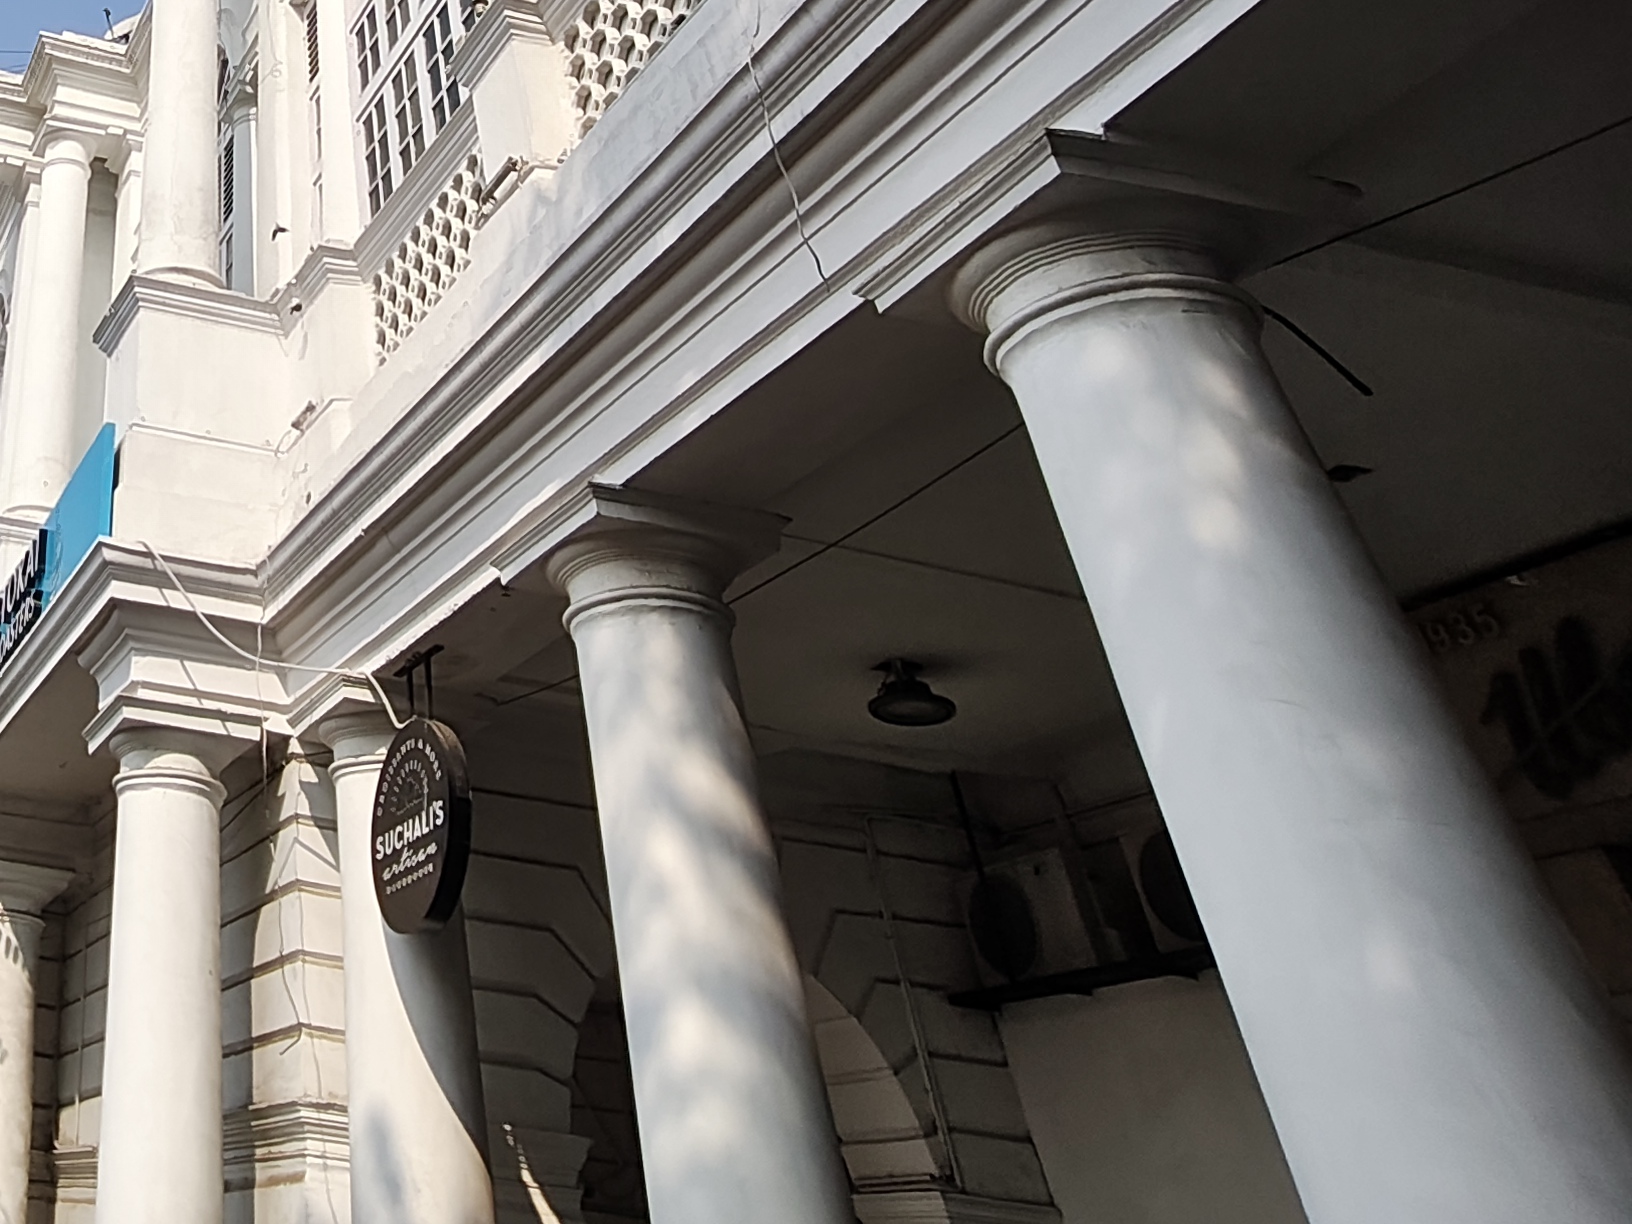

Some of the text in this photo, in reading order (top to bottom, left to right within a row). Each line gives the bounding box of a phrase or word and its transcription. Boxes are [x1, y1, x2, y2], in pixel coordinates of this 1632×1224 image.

[0, 528, 42, 624] TOKAI
[375, 799, 445, 861] SUCHALI'S
[381, 841, 438, 881] artisan
